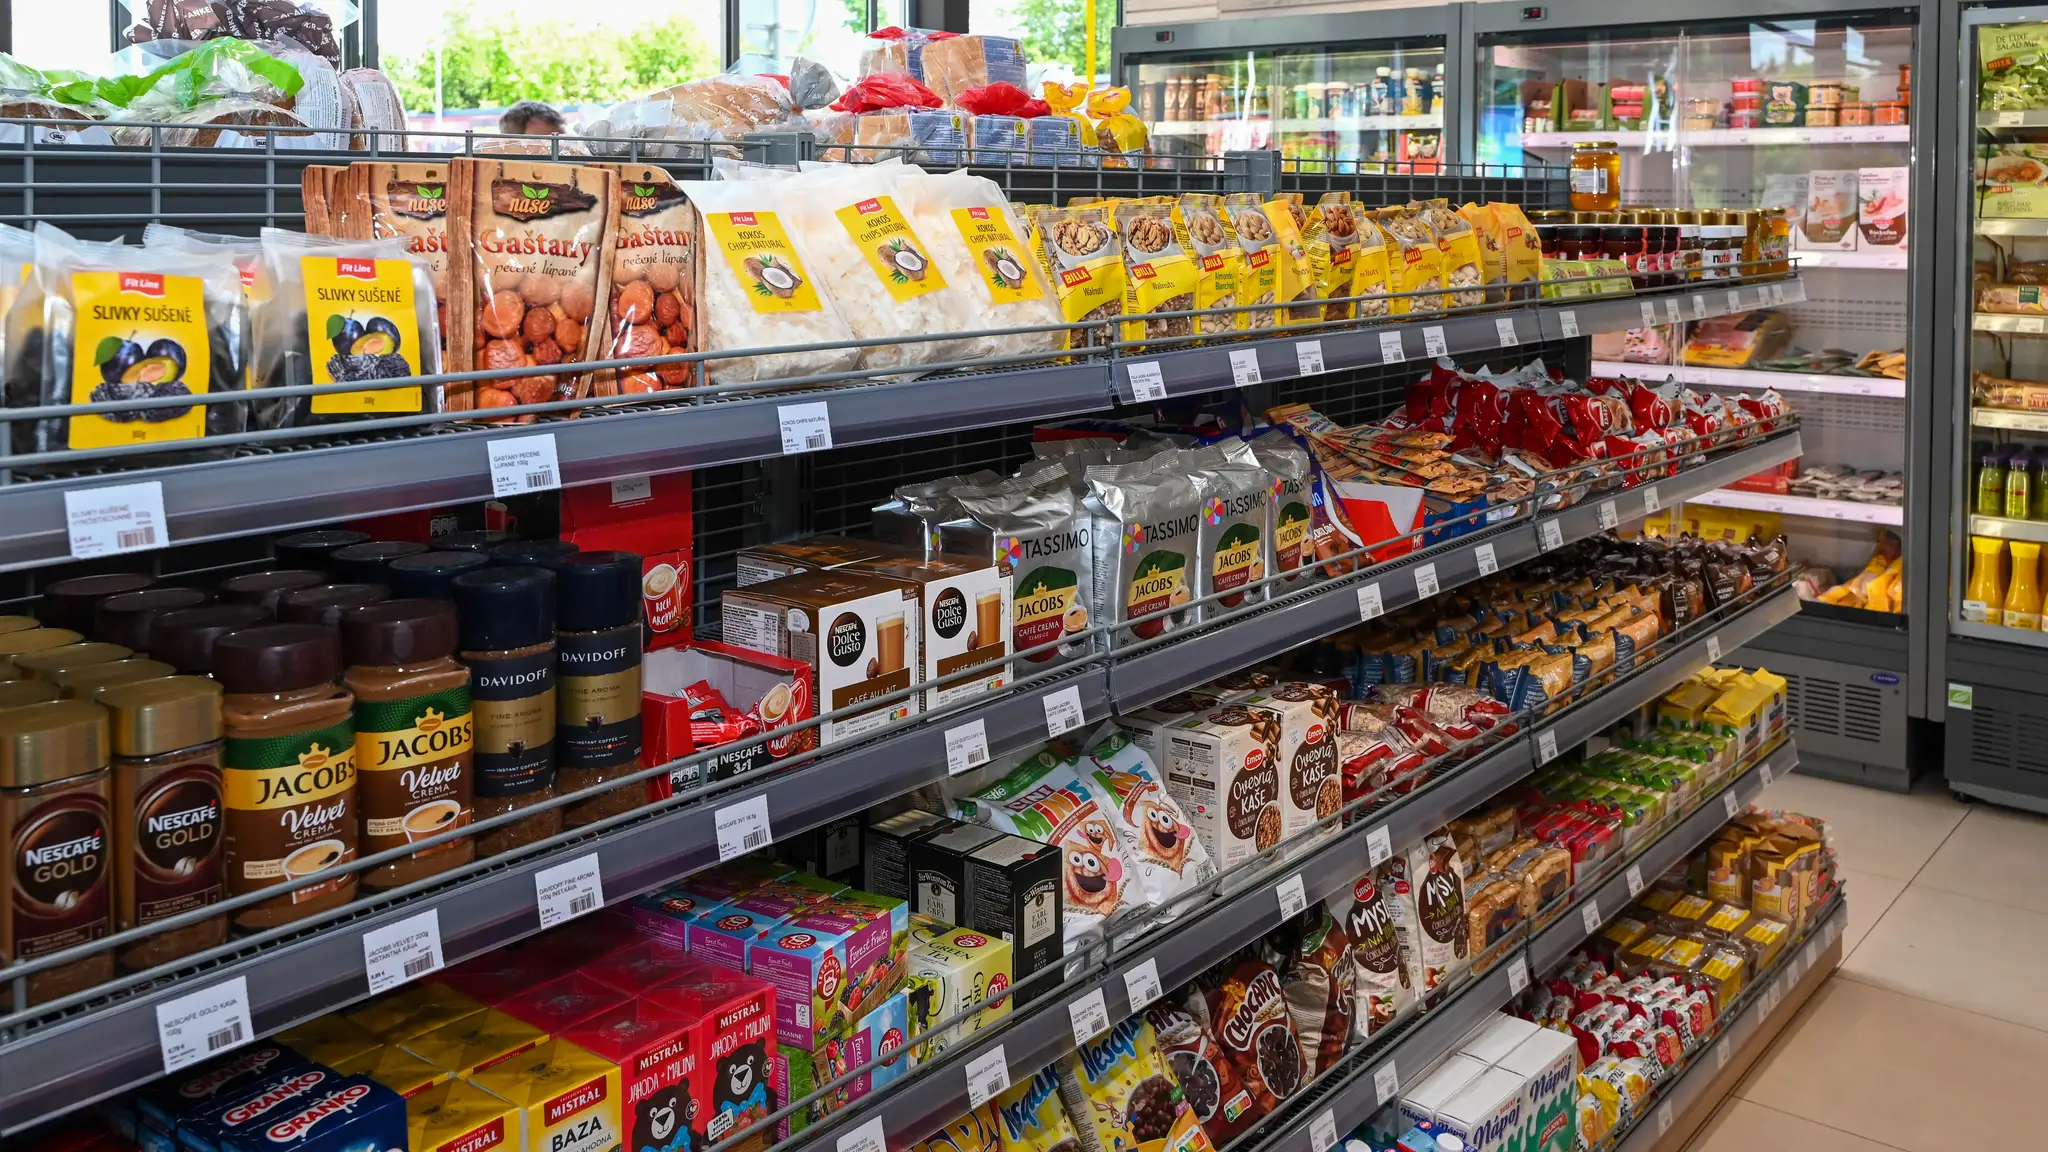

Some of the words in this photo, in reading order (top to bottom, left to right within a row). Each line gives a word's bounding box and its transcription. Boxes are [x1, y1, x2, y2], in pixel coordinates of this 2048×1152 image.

[1996, 41, 2022, 51] SALAD
[860, 202, 869, 212] Fit
[868, 200, 878, 210] Line
[743, 216, 754, 224] Line
[866, 215, 891, 230] KOKOS
[976, 224, 996, 233] KOKOS
[737, 229, 766, 240] KOKOS
[859, 228, 882, 243] CHIPS
[881, 221, 908, 238] NATURAL
[969, 233, 988, 243] CHIPS
[988, 231, 1012, 243] NATURAL
[480, 228, 595, 267] Gaštany
[727, 240, 751, 251] CHIPS
[751, 238, 786, 250] NATURAL
[622, 252, 658, 268] pečené
[1204, 255, 1224, 271] BILLA
[1250, 251, 1270, 268] BILLA
[1333, 249, 1353, 264] BILLA
[1405, 248, 1422, 263] BILLA
[341, 263, 355, 273] Fit
[354, 264, 372, 274] Line
[541, 259, 578, 278] lúpané
[1063, 268, 1089, 286] BILLA
[1133, 264, 1155, 280] BILLA
[125, 278, 140, 290] Fit
[139, 279, 161, 291] Line
[1082, 286, 1104, 298] Walnuts
[1151, 280, 1176, 291] Walnuts
[317, 287, 356, 303] SLIVKY
[358, 286, 402, 304] SUŠENÉ
[92, 305, 141, 323] SLIVKY
[144, 305, 194, 324] SUŠENÉ
[1222, 489, 1268, 517] TASSIMO
[1143, 514, 1199, 545] TASSIMO
[1278, 525, 1302, 546] JACOBS
[1021, 528, 1090, 560] TASSIMO
[1217, 546, 1252, 571] JACOBS
[1232, 570, 1248, 582] CREMA
[1133, 575, 1173, 601] JACOBS
[654, 598, 672, 614] RICH
[1017, 594, 1064, 621] JACOBS
[1148, 600, 1167, 611] CREMA
[651, 607, 679, 628] AROMA
[1037, 620, 1060, 633] CREMA
[834, 620, 858, 634] NESCAFÉ
[832, 630, 861, 648] Dolce
[561, 647, 627, 663] DAVIDOFF
[833, 640, 861, 657] Gusto
[480, 667, 548, 688] DAVIDOFF
[591, 684, 621, 694] AROMA
[848, 692, 868, 706] CAFÉ
[870, 688, 881, 700] AU
[881, 684, 897, 696] LAIT
[490, 711, 512, 721] FINE
[513, 707, 543, 718] AROMA
[598, 736, 619, 745] COFFEE
[1307, 727, 1323, 740] Emco
[376, 721, 472, 767] JACOBS
[1245, 751, 1263, 767] Emco
[1294, 741, 1334, 773] Ovesná
[496, 764, 519, 773] INSTANT
[520, 761, 540, 771] COFFEE
[1301, 762, 1326, 787] KAŠE
[255, 755, 356, 805] JACOBS
[400, 761, 462, 793] Velvet
[1232, 768, 1274, 800] Ovesná
[411, 784, 451, 800] CREMA
[1240, 788, 1266, 816] KAŠE
[147, 799, 217, 834] NESCAFÉ
[281, 798, 346, 834] Velvet
[717, 819, 738, 831] NESCAFE
[155, 822, 214, 850] GOLD
[293, 823, 335, 841] CREMA
[25, 829, 101, 867] NESCAFÉ
[32, 854, 98, 884] GOLD
[539, 881, 564, 895] DAVIDOFF
[564, 877, 576, 886] FINE
[576, 871, 596, 882] AROMA
[925, 872, 947, 887] Winston
[1355, 882, 1371, 898] Emco
[926, 906, 946, 919] GREY
[927, 898, 945, 910] EARL
[1031, 918, 1048, 930] GREY
[1032, 910, 1048, 922] EARL
[368, 943, 392, 958] JACOBS
[391, 935, 415, 948] VELVET
[415, 931, 429, 941] 200g
[849, 937, 873, 963] Forest
[870, 927, 889, 948] Fruits
[1367, 933, 1384, 949] NA
[927, 949, 950, 962] TEA
[928, 942, 974, 960] GREEN
[817, 956, 841, 987] TEEKANNE
[1226, 971, 1279, 1041] CHOCAPIC
[163, 1011, 198, 1029] NESCAFE
[198, 1004, 219, 1017] GOLD
[720, 1002, 761, 1029] MISTRAL
[709, 1032, 738, 1061] JAHODA
[744, 1014, 771, 1041] MALINA
[639, 1041, 685, 1071] MISTRAL
[181, 1048, 279, 1096] GRANKO
[628, 1073, 659, 1104] JAHODA
[666, 1054, 696, 1082] MALINA
[1528, 1054, 1573, 1104] Nápoj
[225, 1072, 325, 1123] GRANKO
[551, 1087, 601, 1120] MISTRAL
[269, 1085, 370, 1139] GRANKO
[1473, 1098, 1522, 1147] Nápoj
[552, 1116, 602, 1152] BAZA
